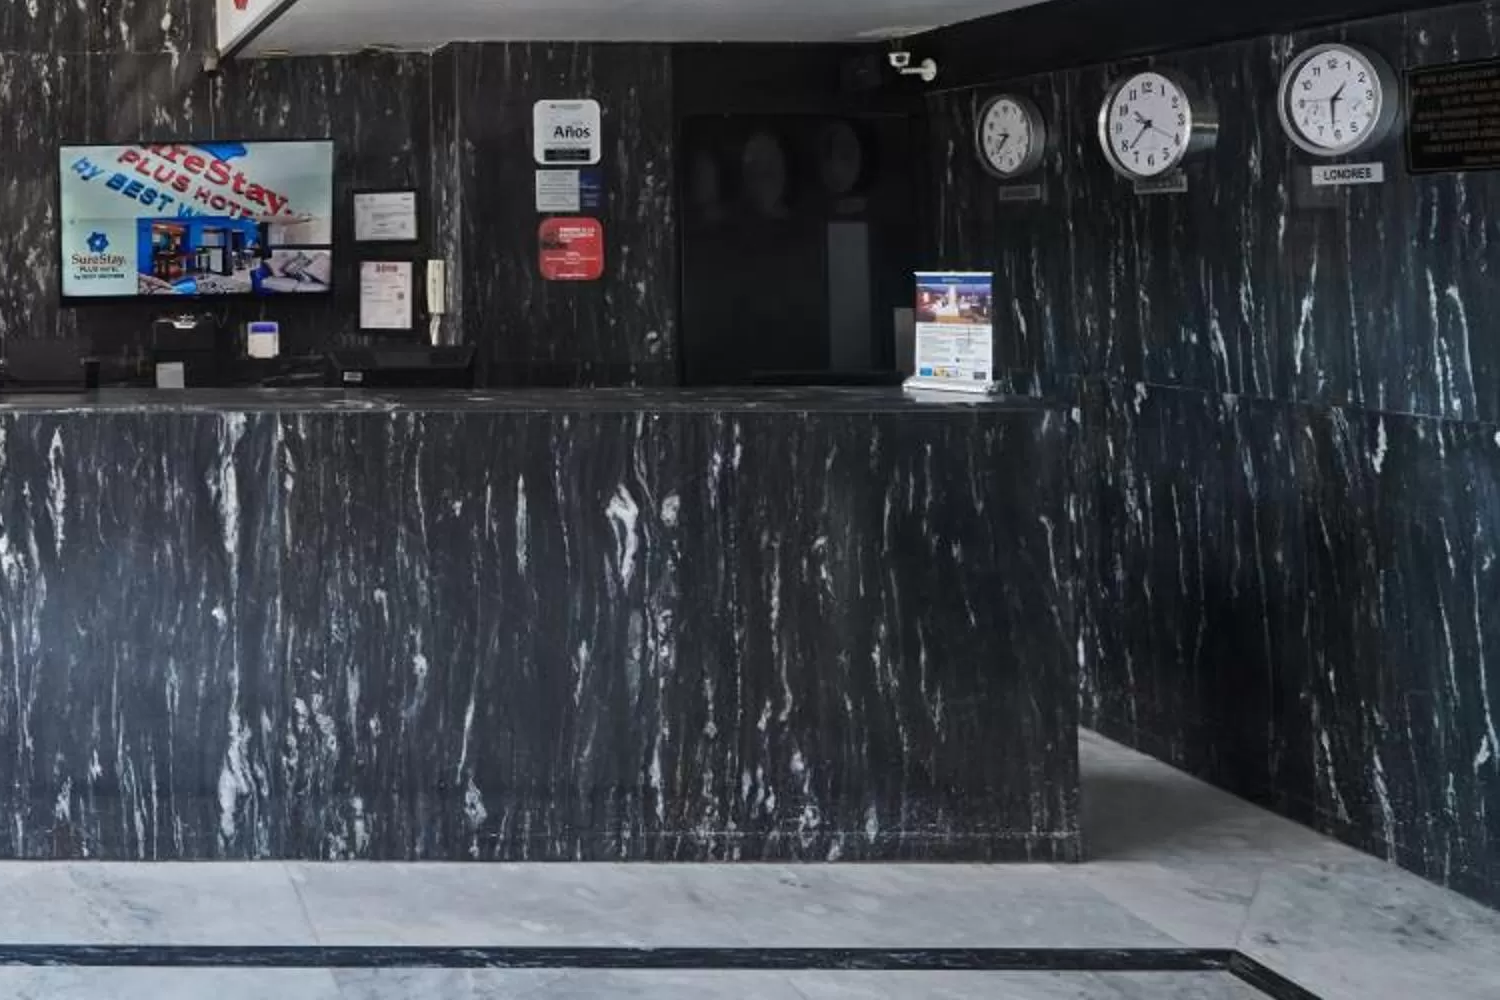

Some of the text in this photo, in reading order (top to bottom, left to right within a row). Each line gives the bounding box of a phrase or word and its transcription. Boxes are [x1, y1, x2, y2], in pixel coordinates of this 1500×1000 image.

[553, 124, 591, 139] Años
[71, 156, 106, 182] by
[105, 172, 175, 213] BEST
[116, 150, 192, 193] PLUS
